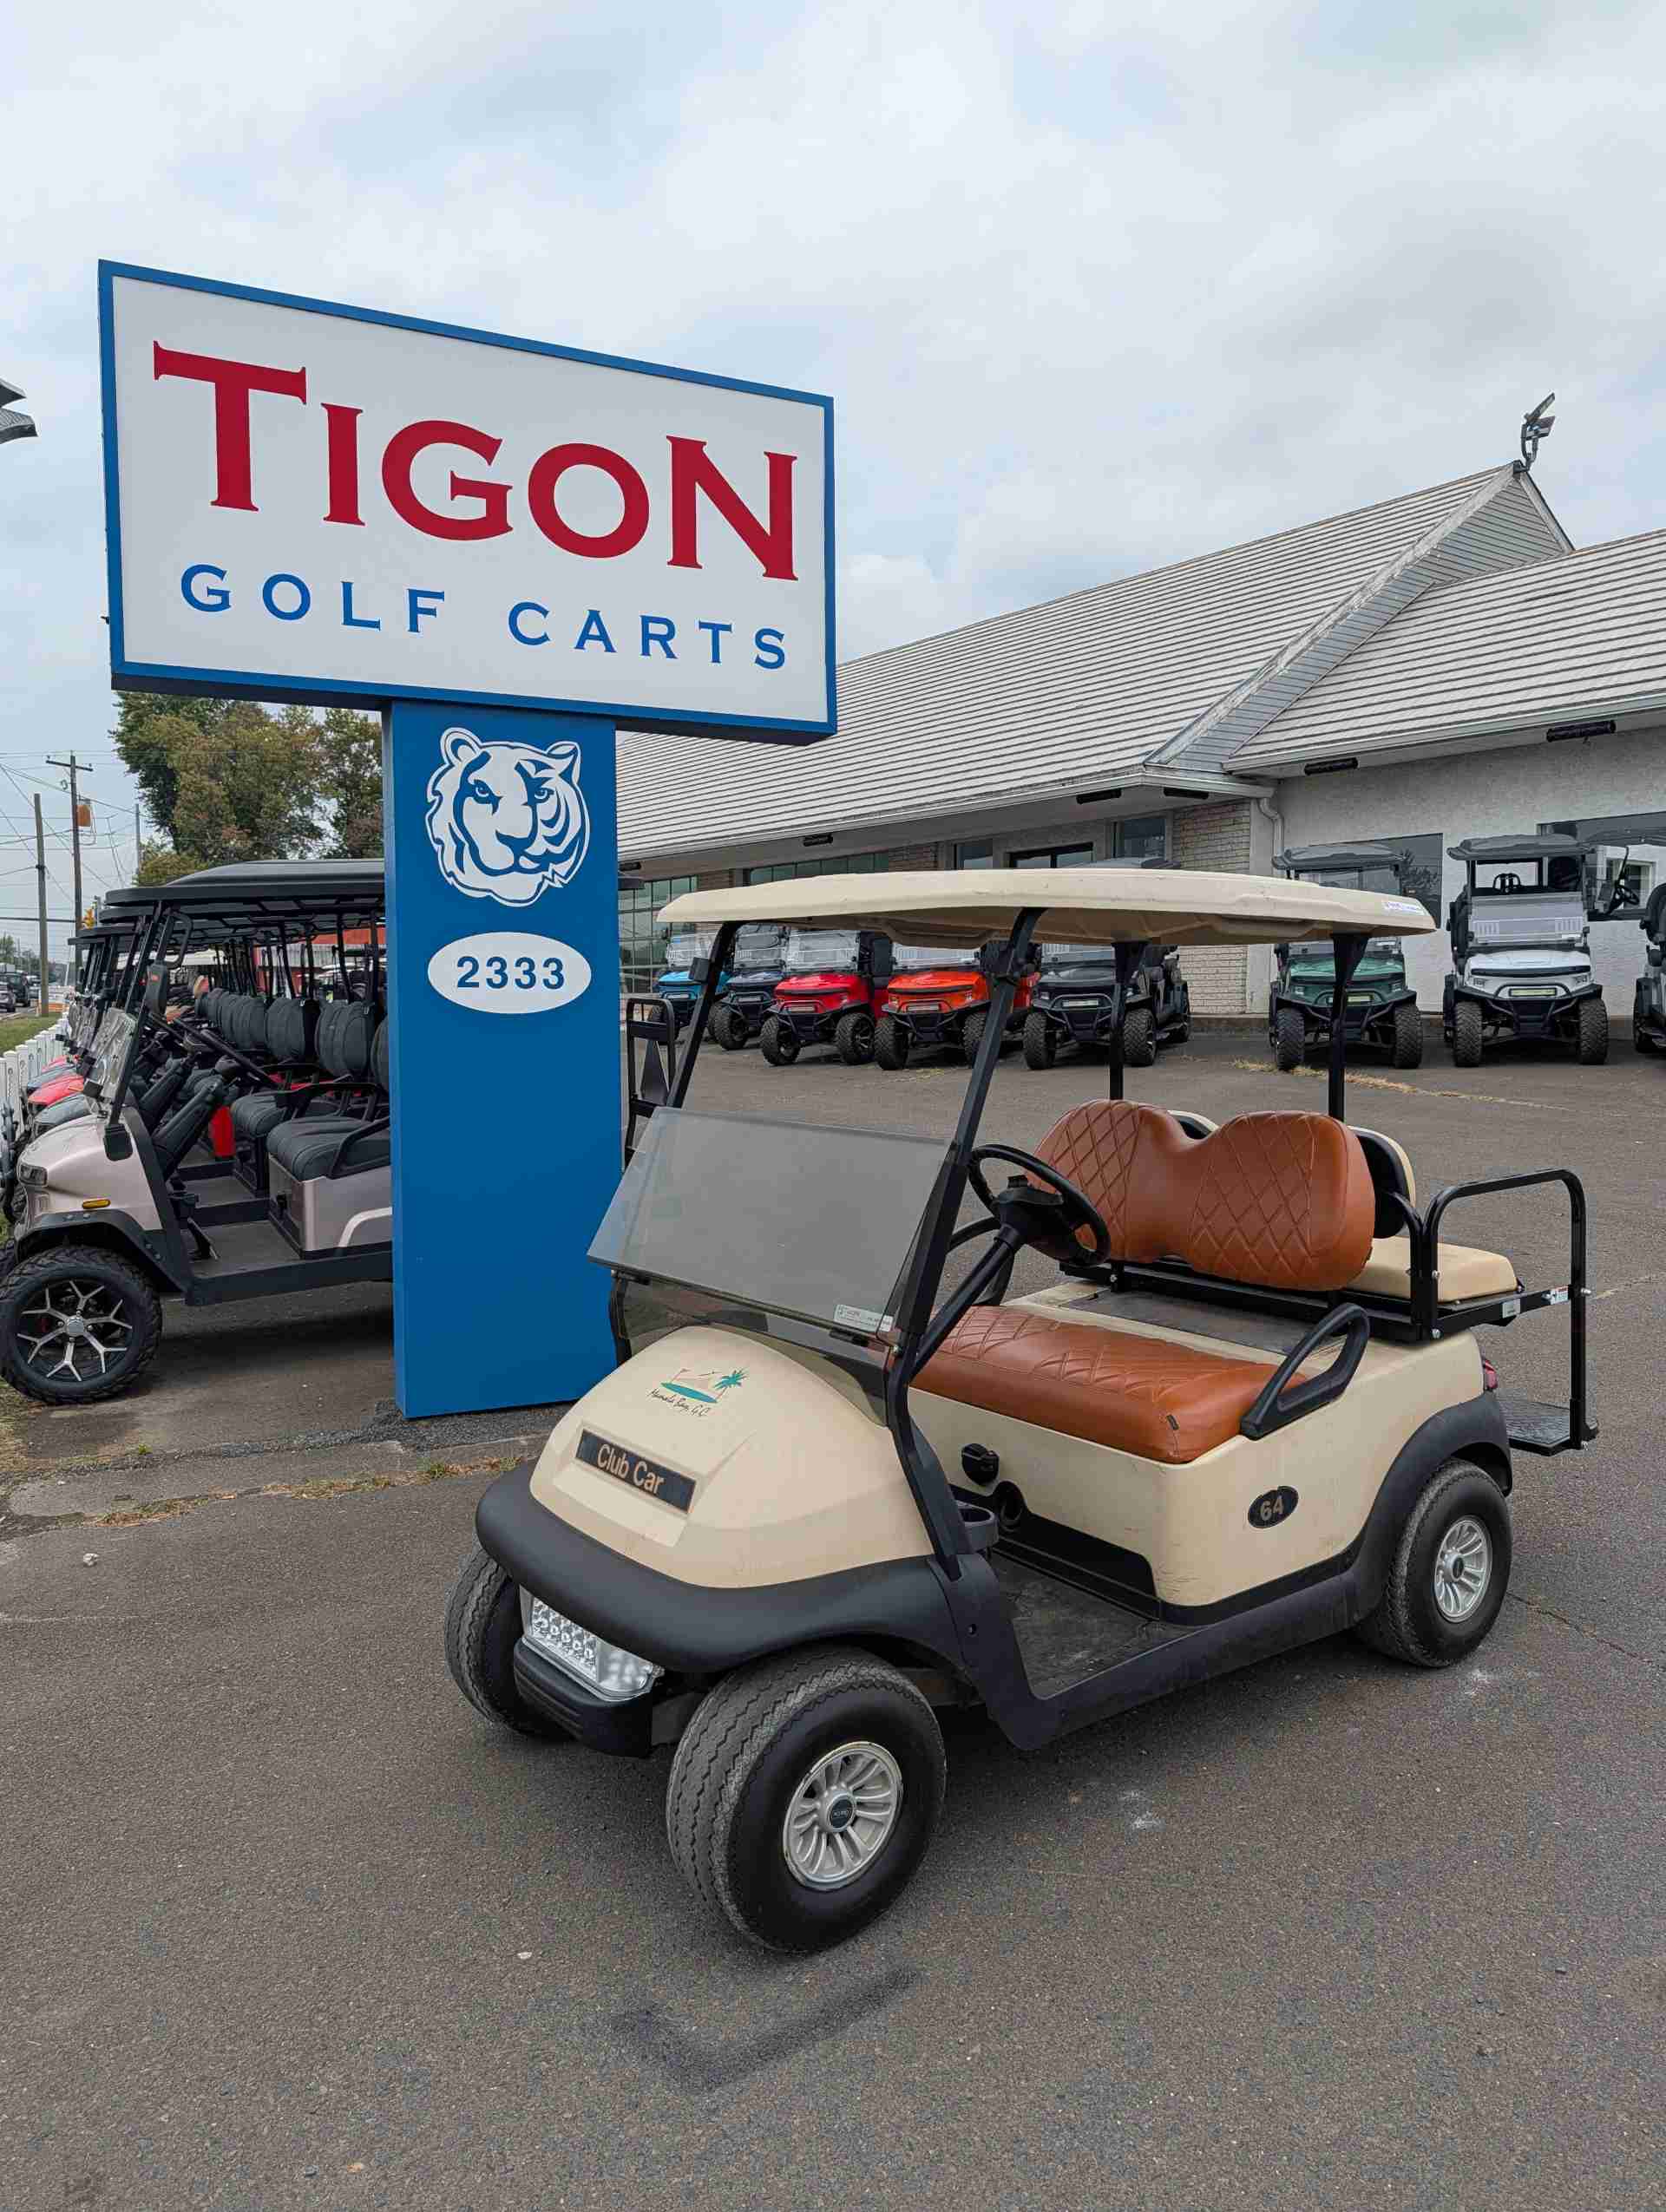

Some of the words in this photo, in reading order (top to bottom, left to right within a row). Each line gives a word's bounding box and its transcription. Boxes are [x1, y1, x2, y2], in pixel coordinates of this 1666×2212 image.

[154, 339, 798, 581] TIGON
[180, 564, 445, 633] GOLF
[508, 601, 786, 670] CARTS
[456, 956, 564, 990] 2333
[597, 1443, 629, 1478] Club
[633, 1461, 665, 1495] Car
[1261, 1495, 1284, 1521] 64
